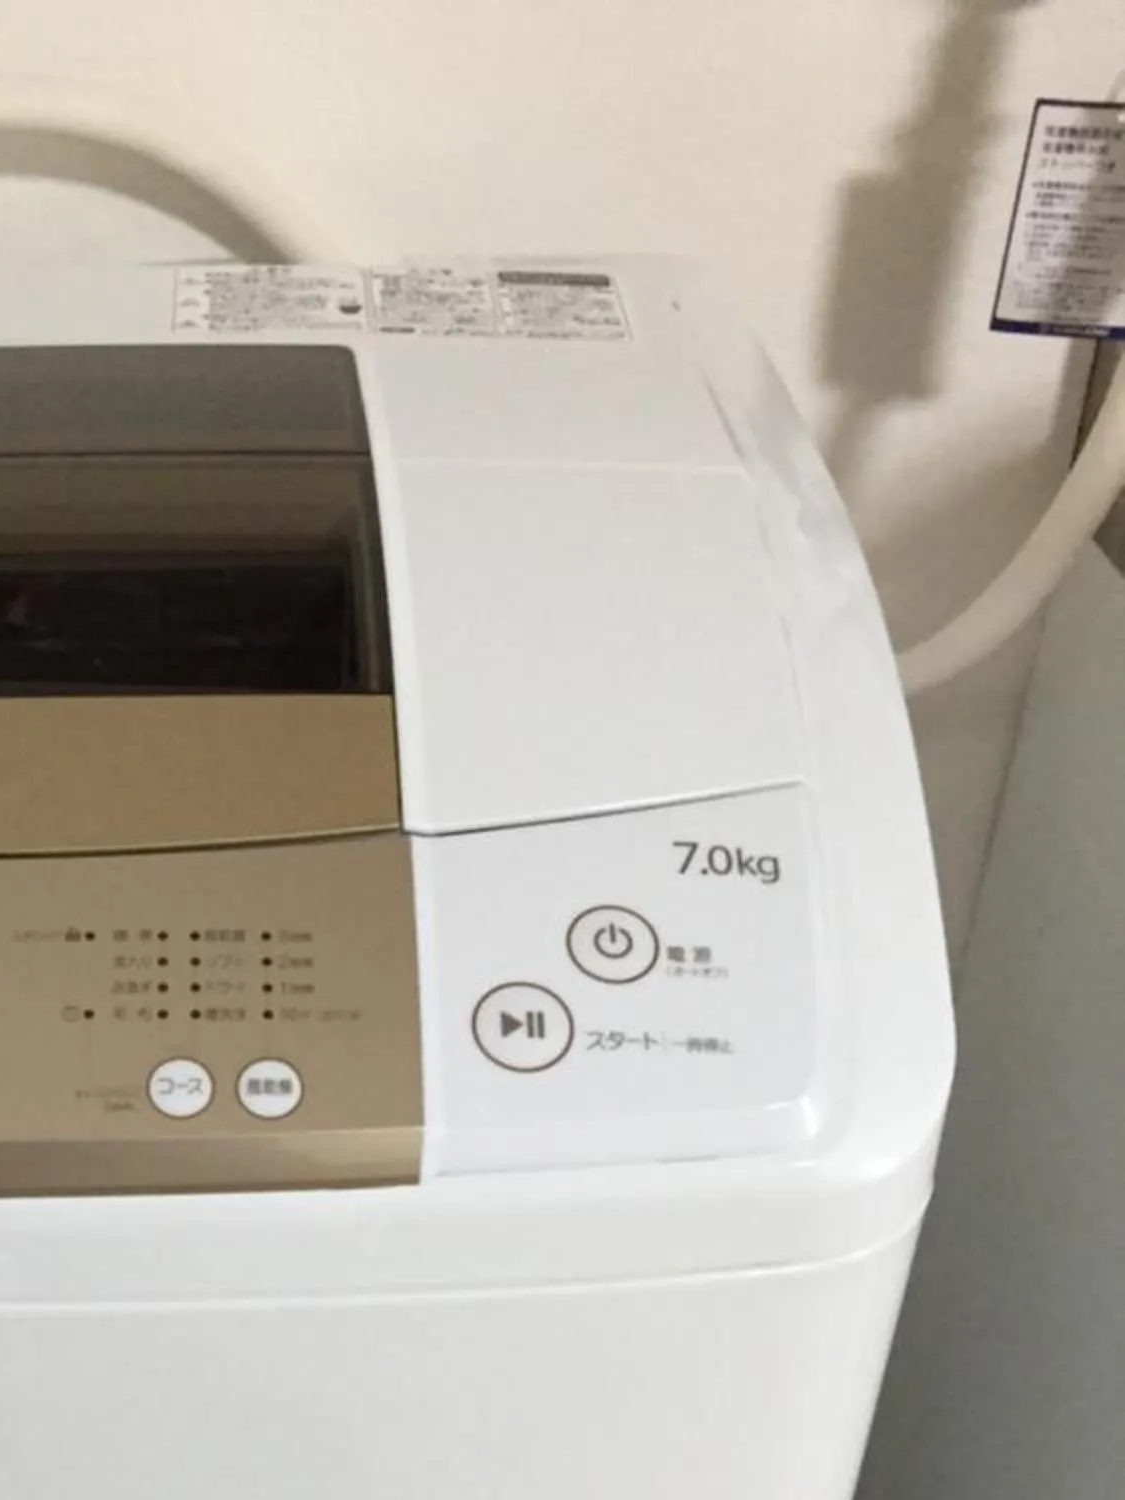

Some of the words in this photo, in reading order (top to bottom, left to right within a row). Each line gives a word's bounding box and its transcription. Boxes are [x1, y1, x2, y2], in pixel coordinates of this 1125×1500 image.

[672, 841, 780, 884] 7.0kg
[585, 1030, 658, 1051] スタート
[157, 1077, 204, 1096] コース
